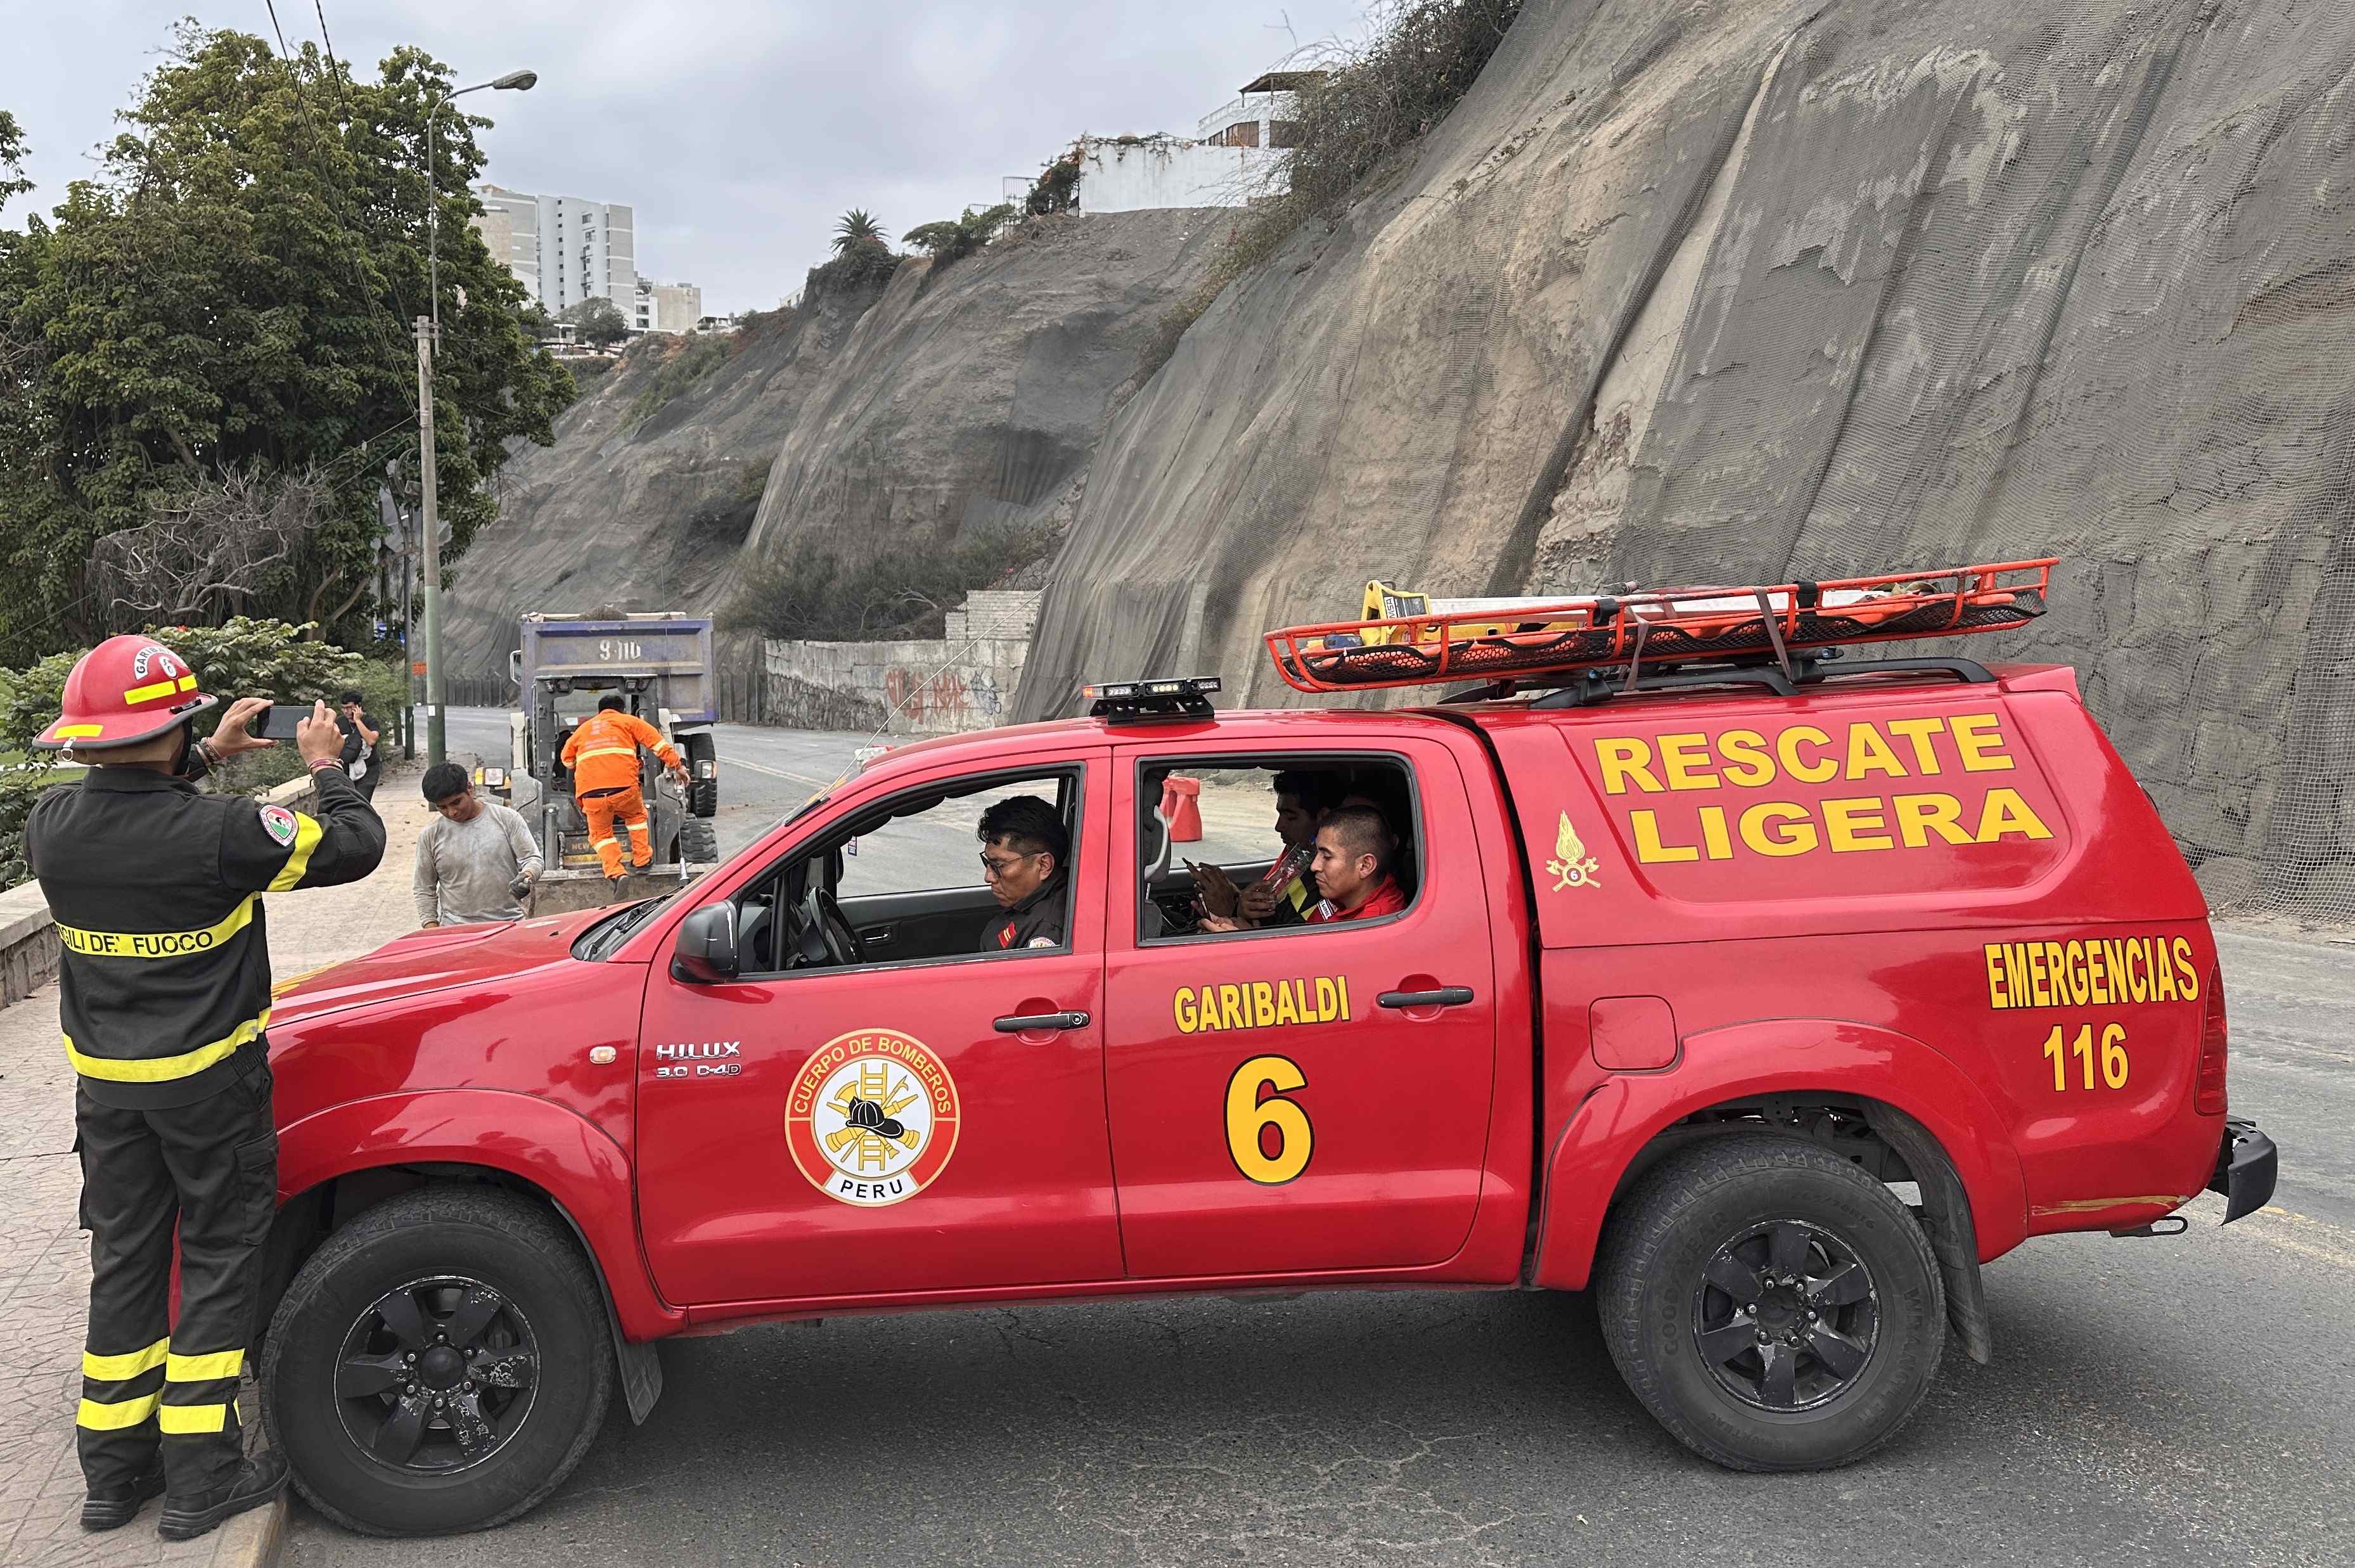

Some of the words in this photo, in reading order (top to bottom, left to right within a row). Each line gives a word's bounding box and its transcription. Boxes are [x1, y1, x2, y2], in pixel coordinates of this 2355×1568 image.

[1593, 712, 2016, 795] RESCATE
[1629, 787, 2055, 865] LIGERA
[1569, 870, 1579, 880] 6
[132, 930, 213, 955] FUOCO
[1984, 935, 2200, 1010] EMERGENCIAS
[1173, 975, 1351, 1034] GARIBALDI
[656, 1041, 741, 1060] HILUX
[793, 1046, 846, 1114] CUERPO
[848, 1036, 873, 1056] DE
[877, 1036, 953, 1114] BOMBEROS
[2043, 1022, 2130, 1092] 116
[1223, 1053, 1315, 1187] 6
[840, 1179, 903, 1199] PERU
